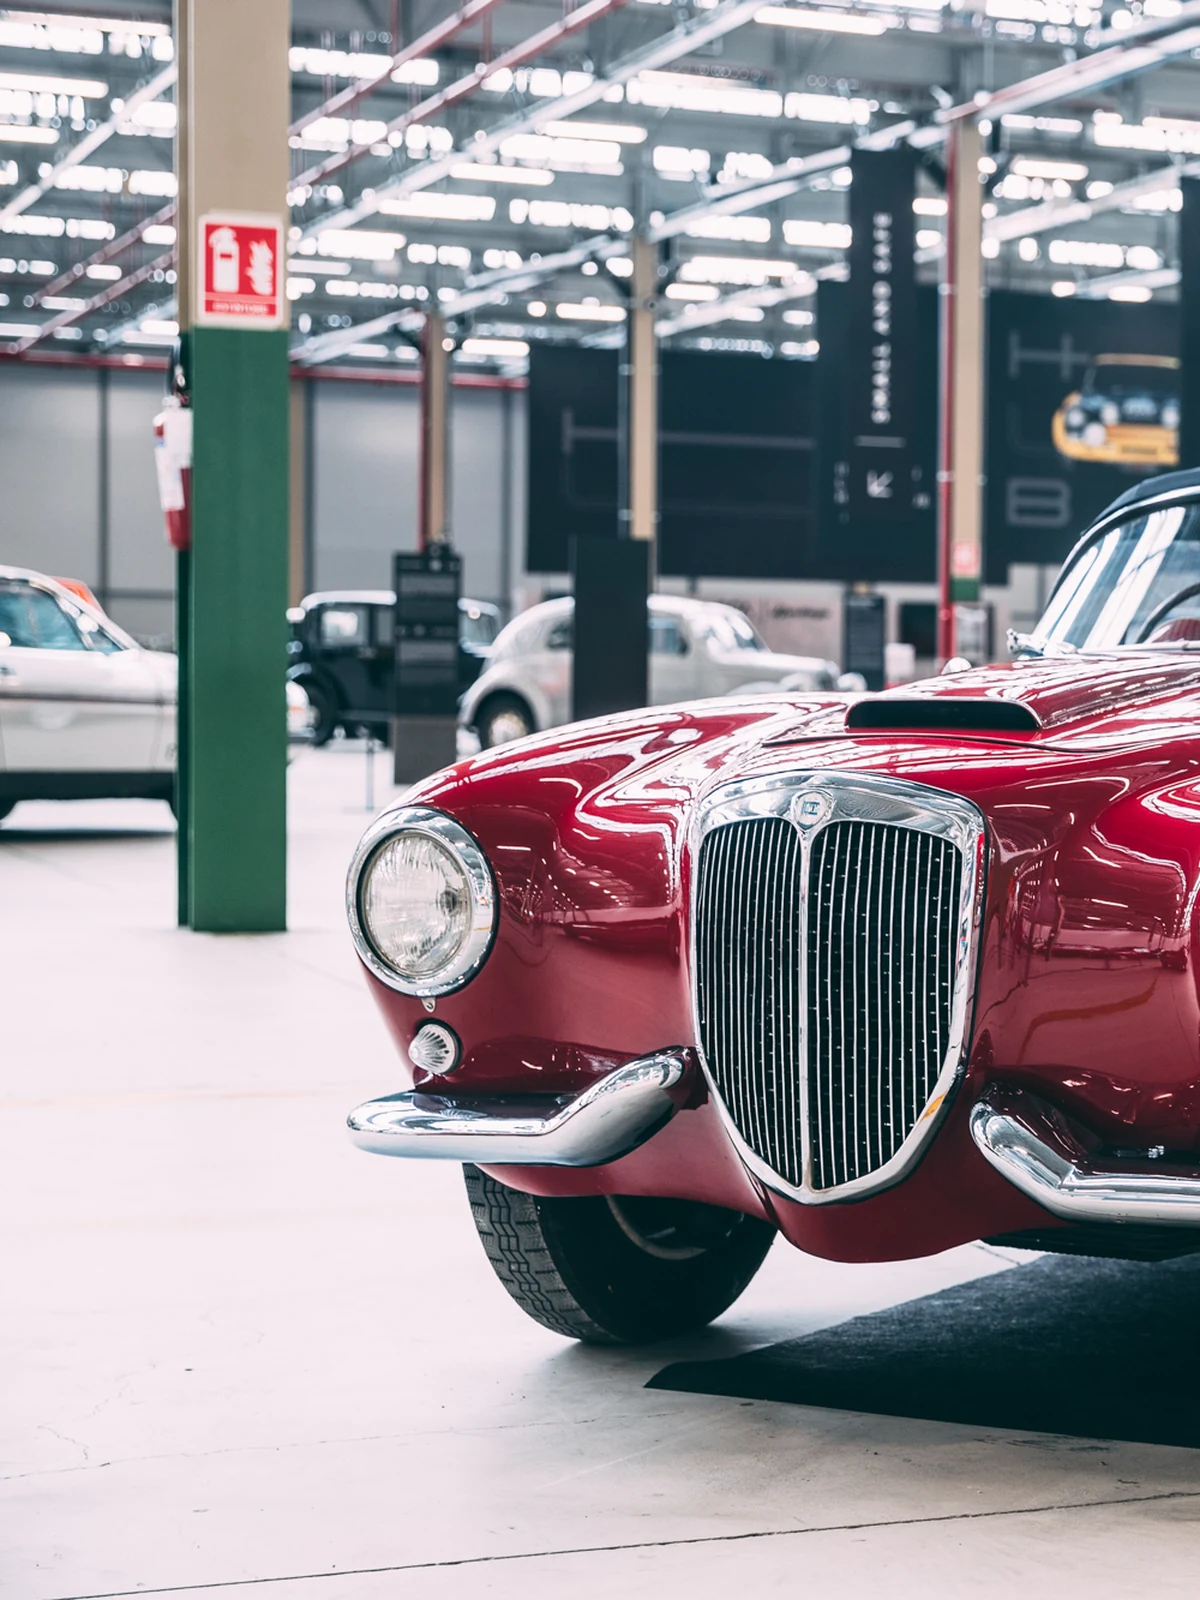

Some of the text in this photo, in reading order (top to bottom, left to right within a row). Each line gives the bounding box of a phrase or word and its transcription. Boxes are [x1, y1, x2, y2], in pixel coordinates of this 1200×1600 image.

[871, 211, 892, 424] SMALL AND SAFE
